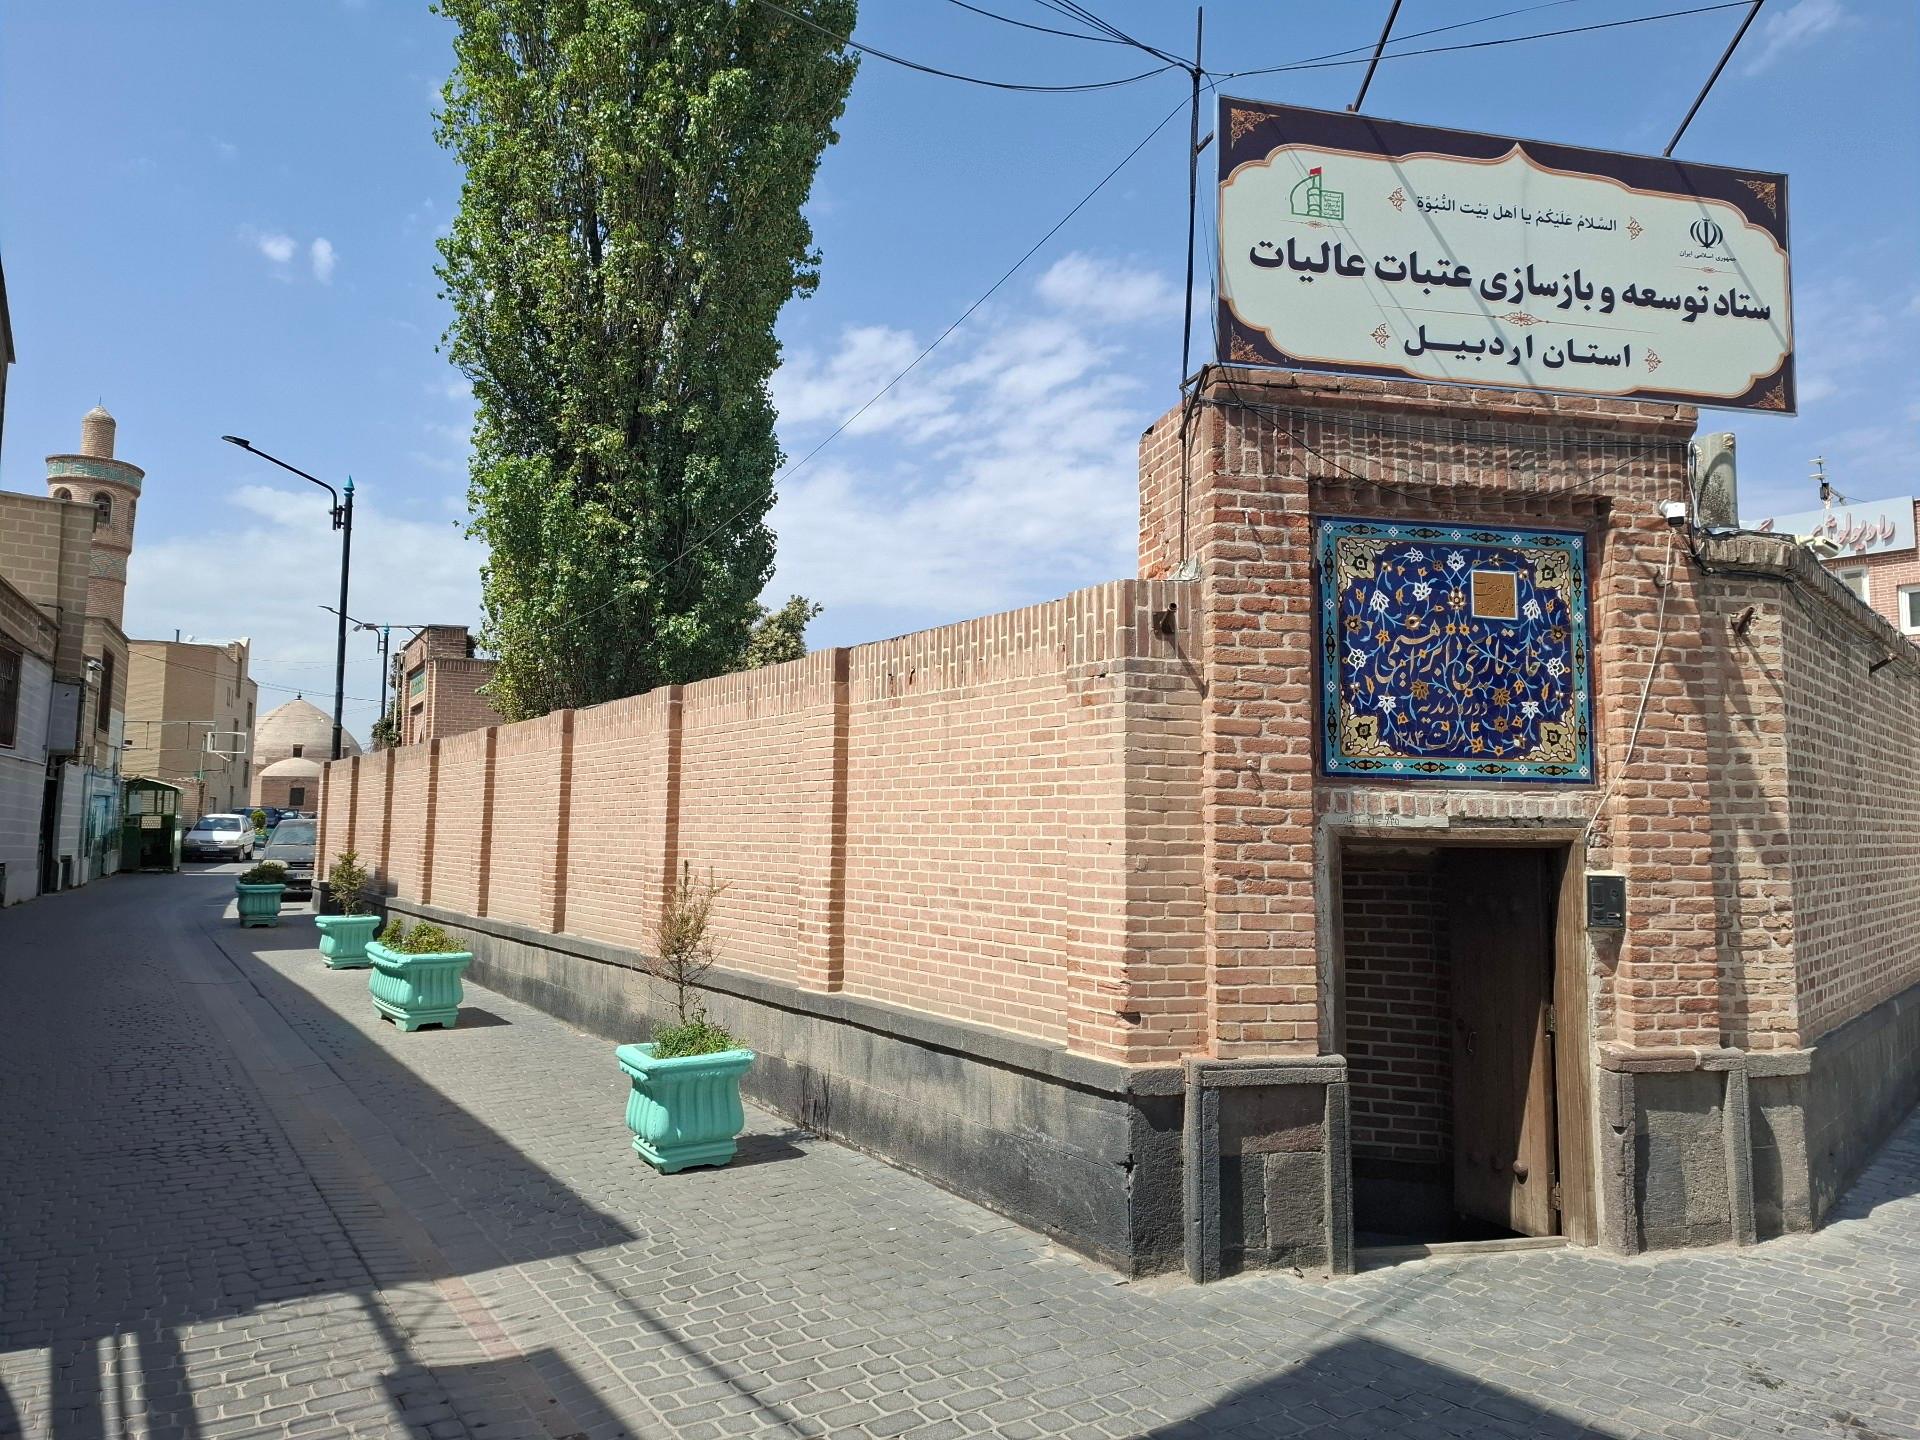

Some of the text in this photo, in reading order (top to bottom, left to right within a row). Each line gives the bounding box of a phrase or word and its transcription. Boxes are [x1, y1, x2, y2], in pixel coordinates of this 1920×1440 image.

[1249, 237, 1771, 322] ستاد توسعه و بازسازی عتبات عالیات
[1404, 324, 1631, 369] استان اردبیل
[1452, 625, 1515, 691] تاریخی
[1508, 636, 1541, 678] خانه
